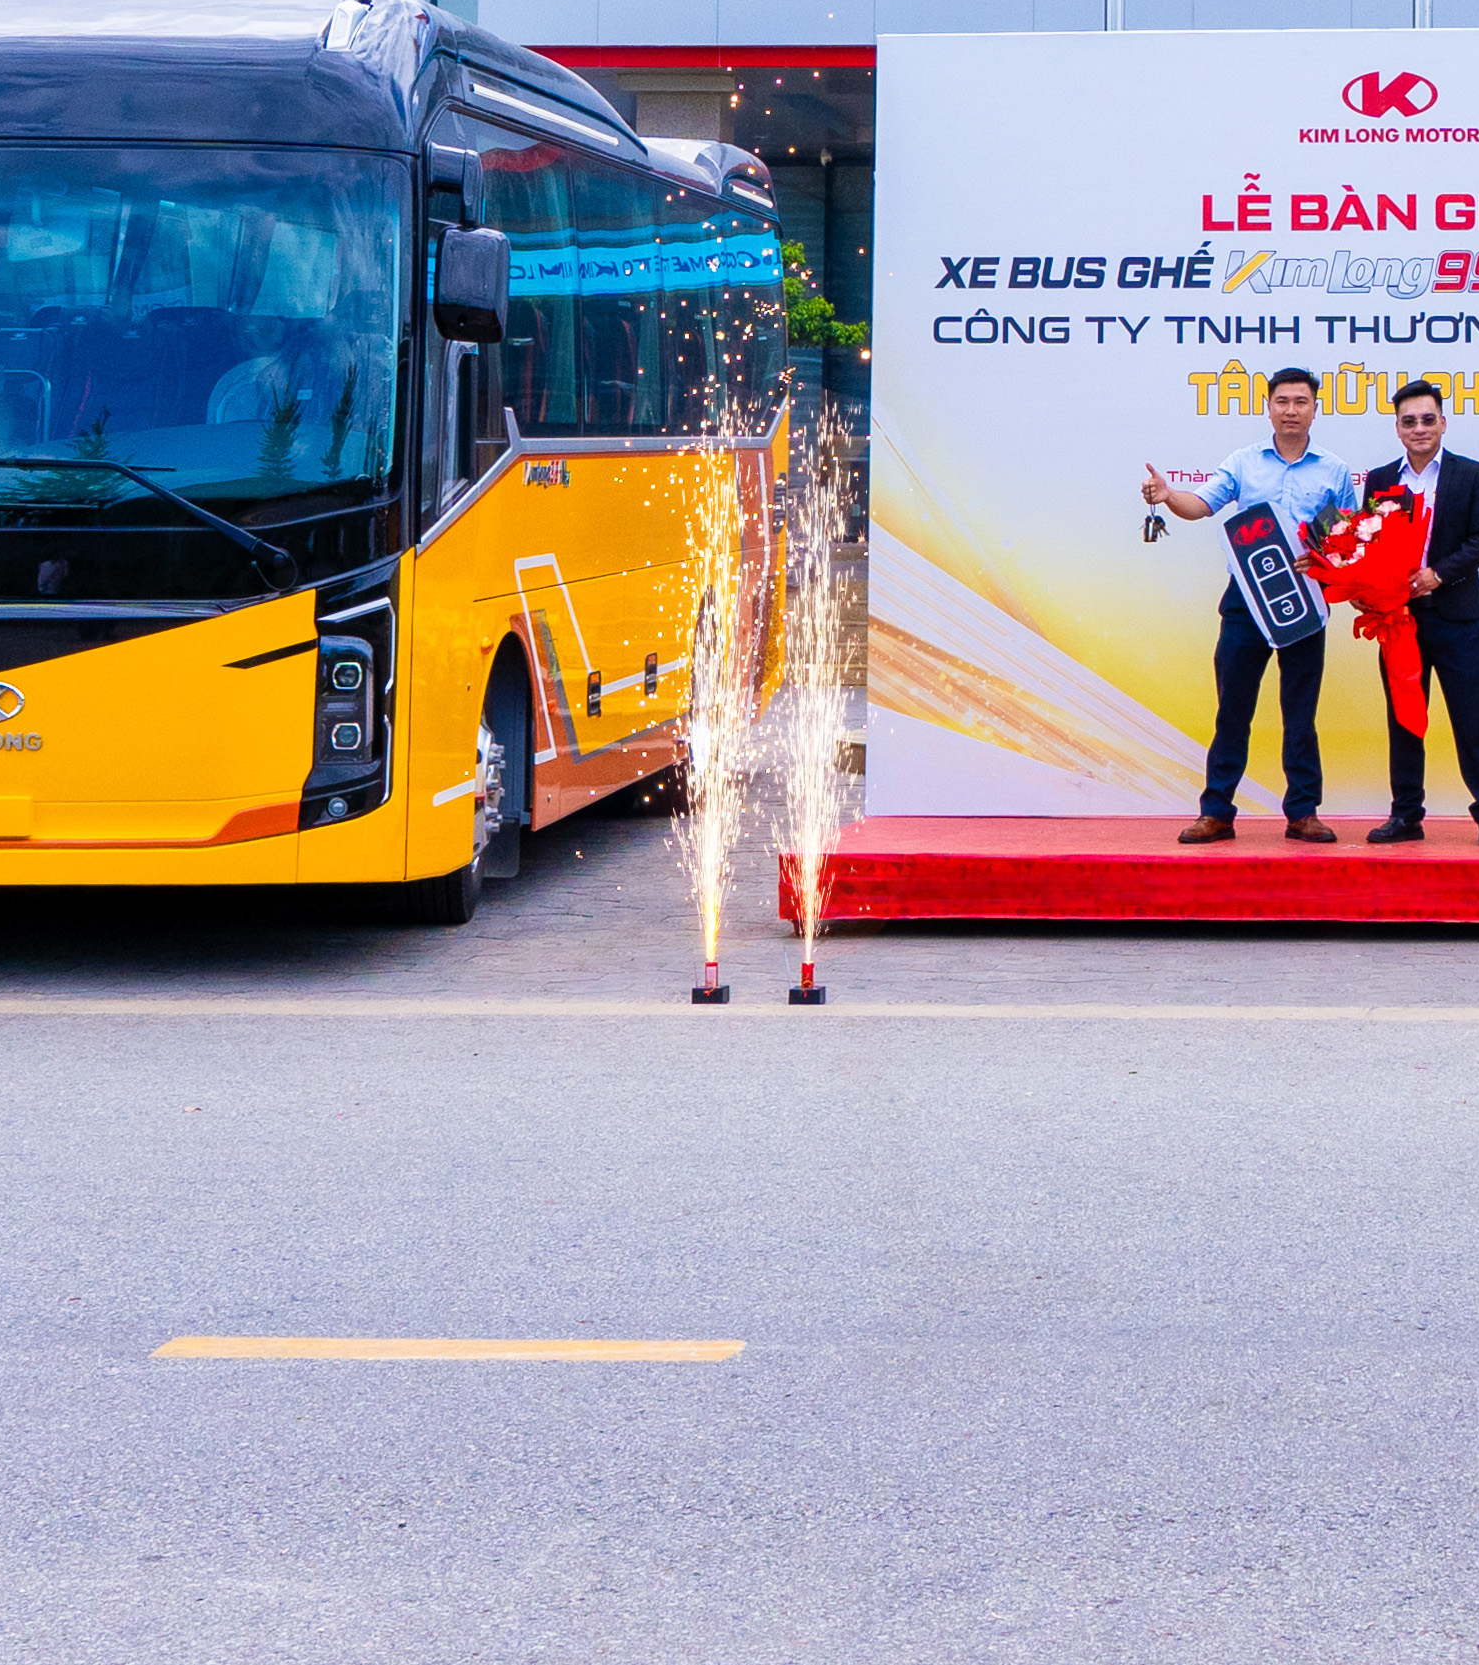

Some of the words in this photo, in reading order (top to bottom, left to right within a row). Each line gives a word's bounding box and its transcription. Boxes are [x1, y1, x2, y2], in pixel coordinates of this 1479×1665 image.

[1299, 128, 1340, 143] KIM
[1344, 128, 1400, 143] LONG
[1202, 172, 1272, 232] LỄ
[1291, 184, 1418, 232] BÀN
[934, 256, 1001, 290] XE
[1007, 256, 1107, 290] BUS
[1117, 240, 1215, 290] GHẾ
[932, 308, 1071, 344] CÔNG
[1084, 315, 1151, 344] TY
[1164, 315, 1300, 344] TNHH
